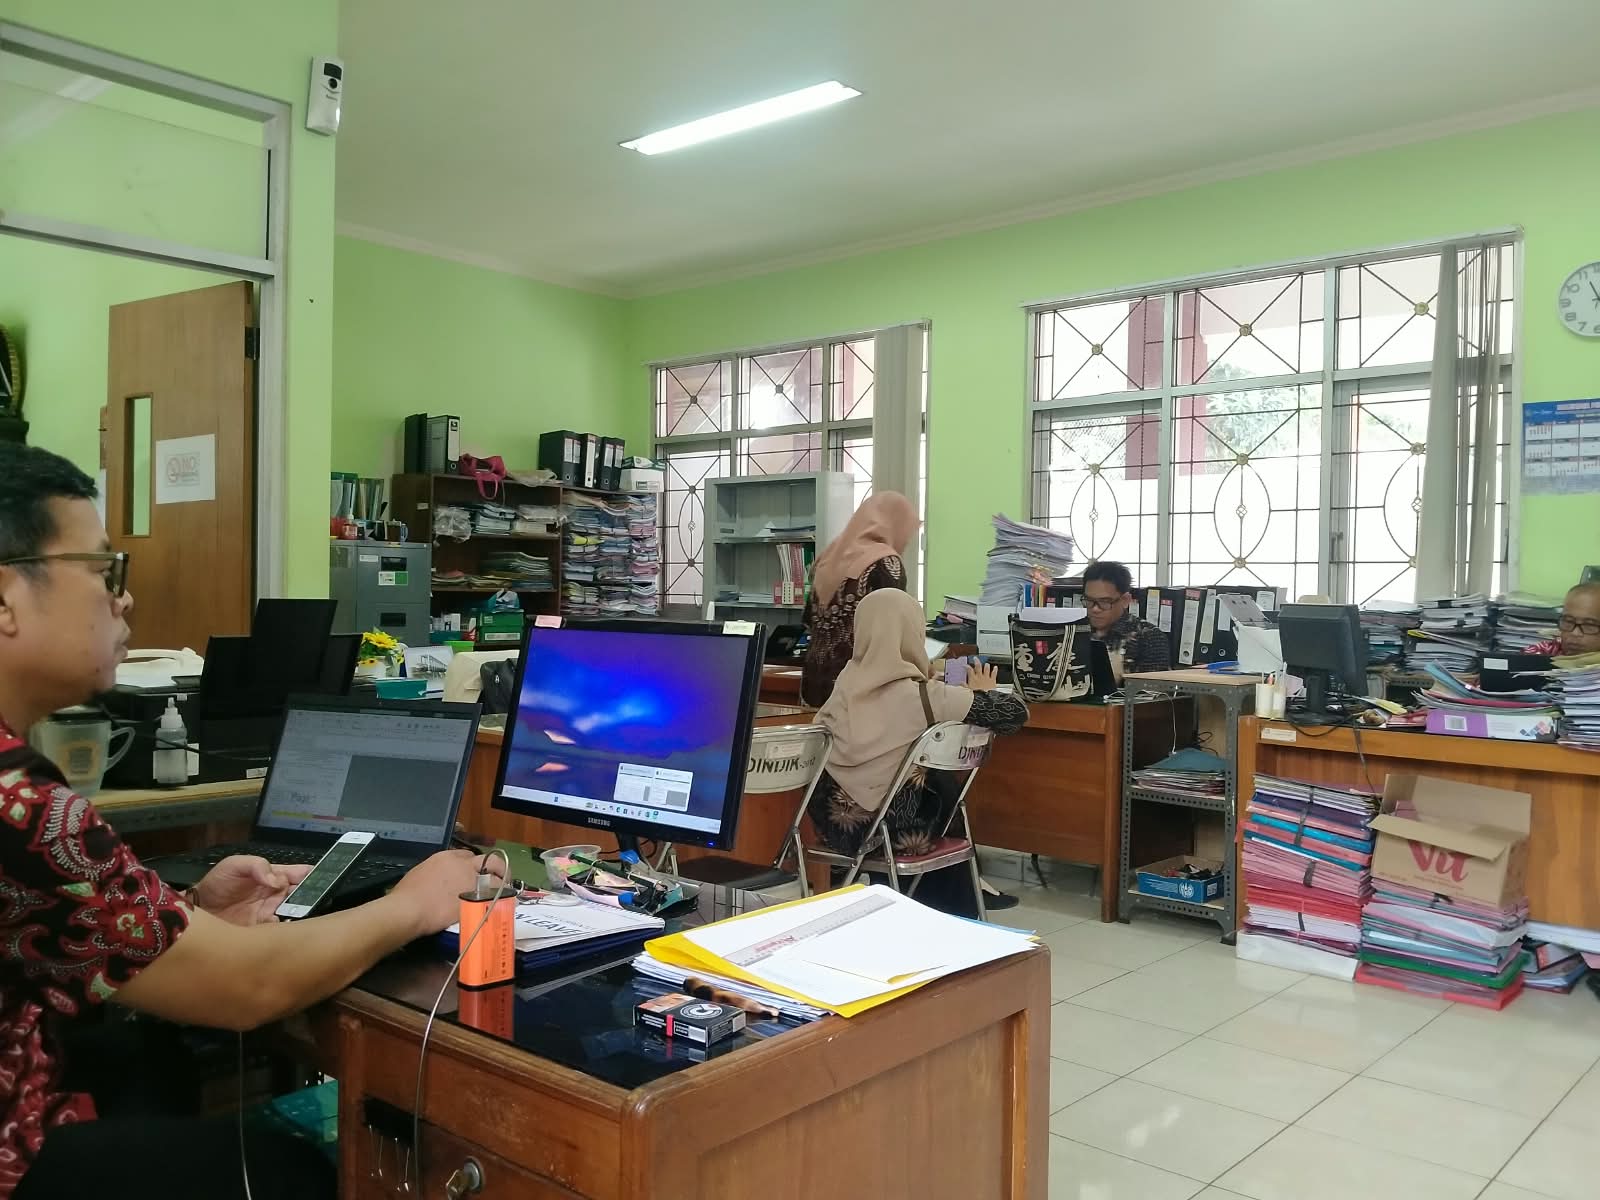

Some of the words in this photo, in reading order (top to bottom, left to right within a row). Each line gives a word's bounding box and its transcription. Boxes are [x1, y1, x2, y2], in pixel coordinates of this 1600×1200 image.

[1577, 321, 1588, 332] 7
[587, 817, 611, 827] SAMSUNG
[521, 915, 584, 935] LEAVE
